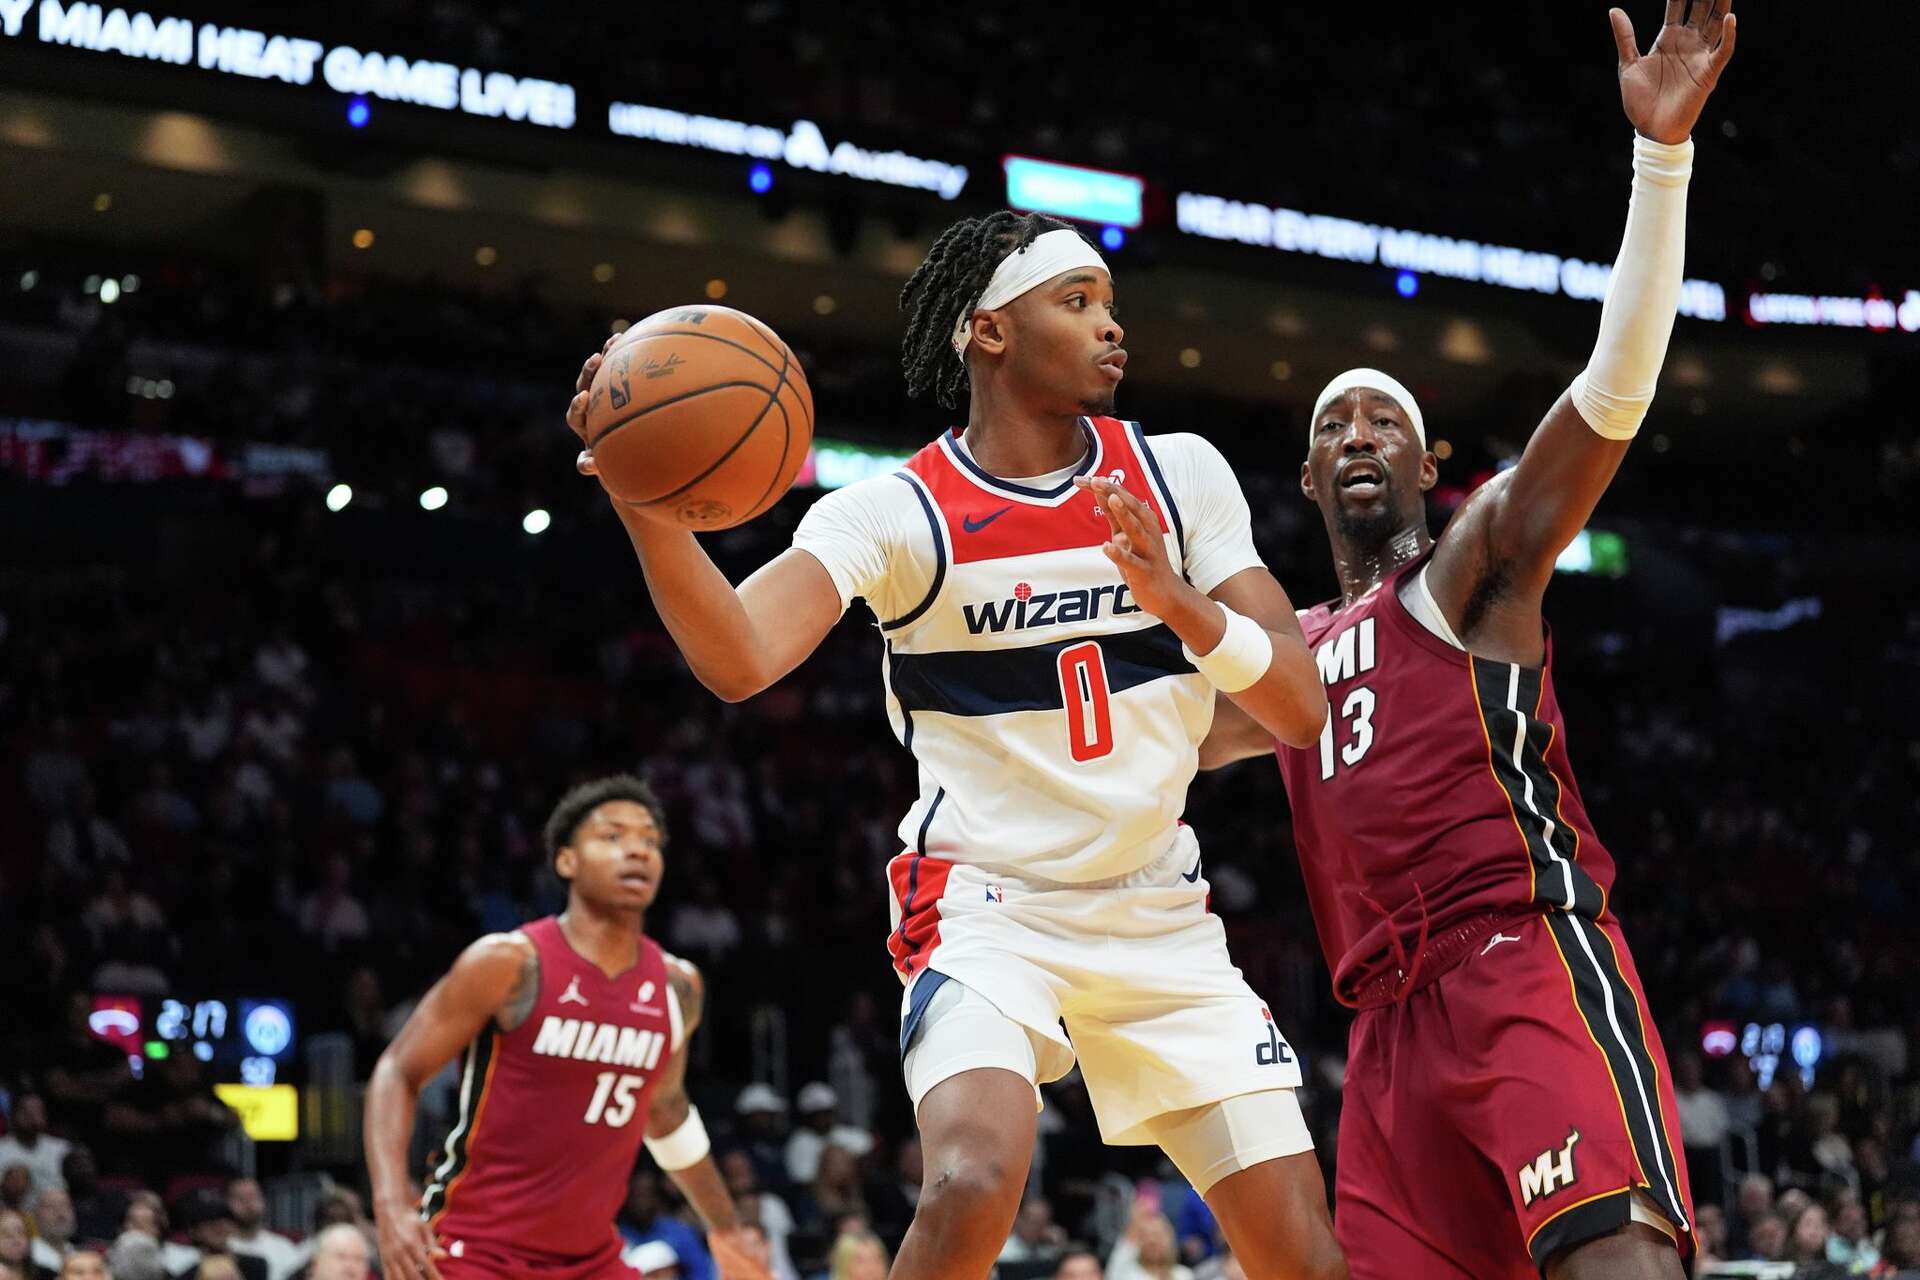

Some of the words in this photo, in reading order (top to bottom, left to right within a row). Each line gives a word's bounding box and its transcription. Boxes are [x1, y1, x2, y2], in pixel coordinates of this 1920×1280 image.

[38, 0, 194, 66] MIAMI
[197, 23, 324, 86] HEAT
[323, 46, 460, 111] GAME
[1057, 640, 1115, 766] 0
[1319, 686, 1376, 781] 13
[532, 1015, 666, 1071] MIAMI
[583, 1071, 645, 1128] 15
